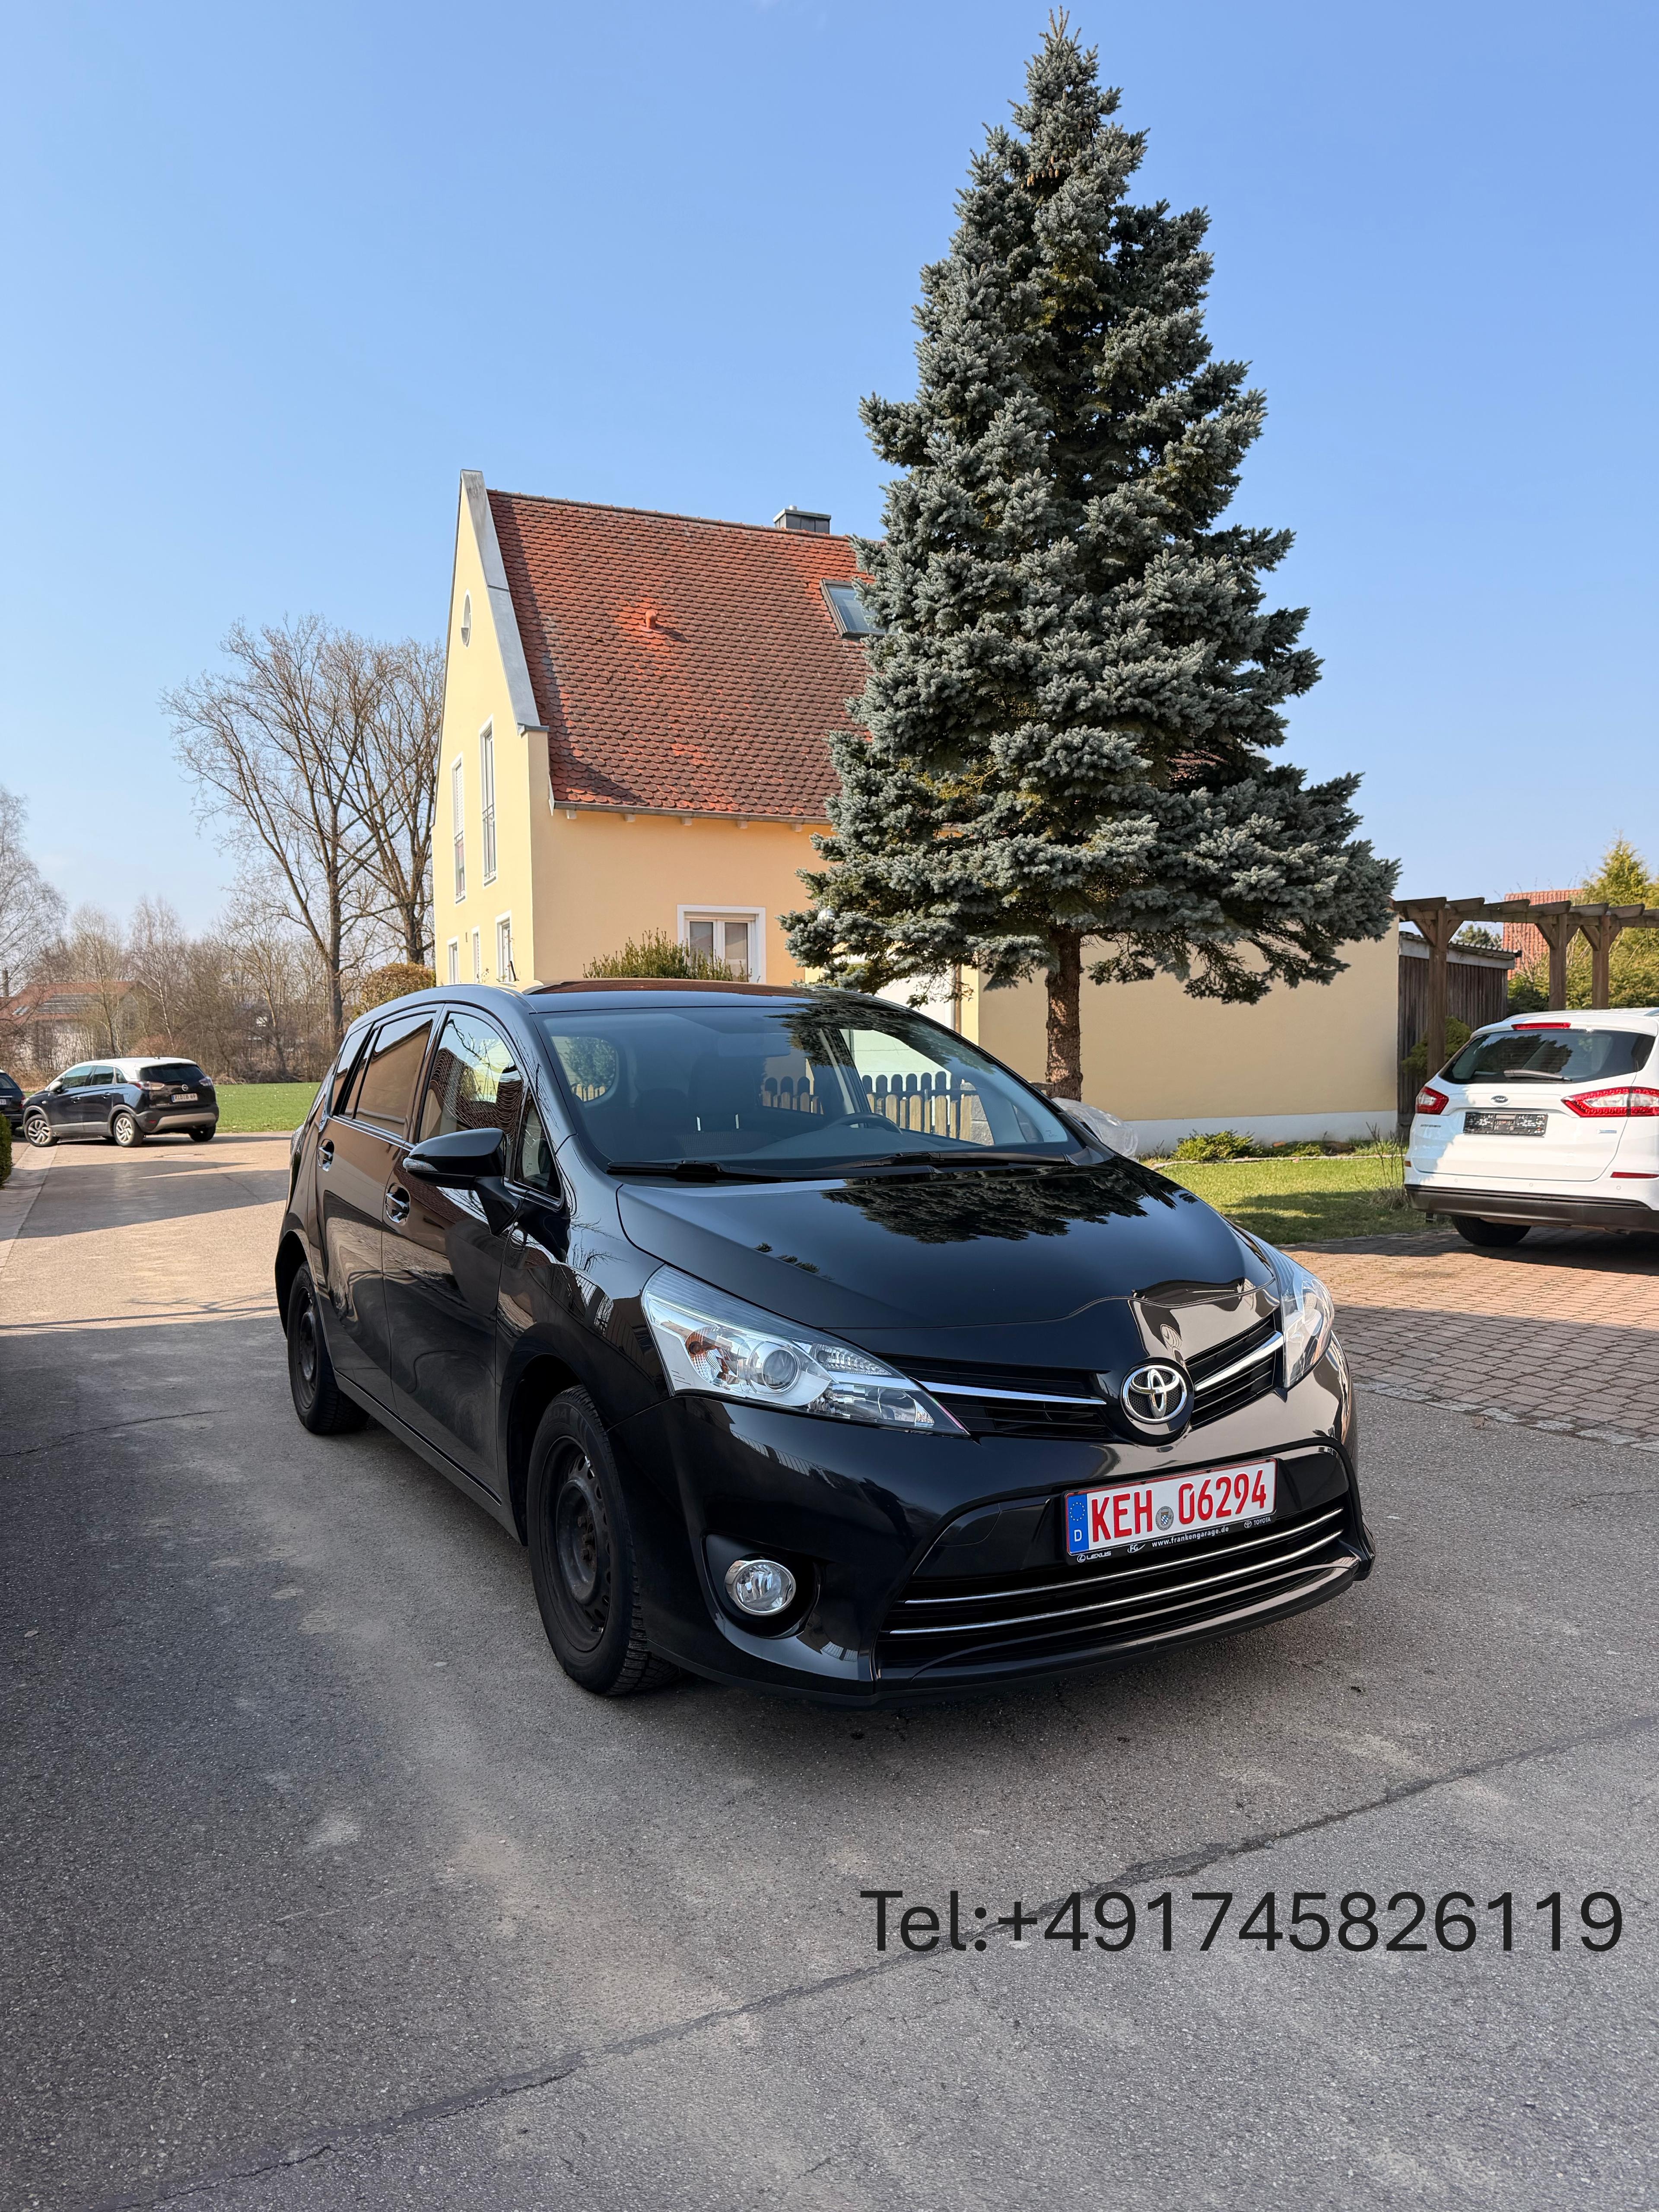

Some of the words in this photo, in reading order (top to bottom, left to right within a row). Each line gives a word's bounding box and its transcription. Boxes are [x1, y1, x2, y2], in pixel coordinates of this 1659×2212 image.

[1092, 1490, 1153, 1542] KEH
[1179, 1470, 1267, 1524] 06294
[1253, 1516, 1271, 1526] TOYOTA
[1074, 1529, 1082, 1542] D
[1151, 1526, 1229, 1548] www.frankengarage.de
[1087, 1551, 1112, 1560] LEXUS
